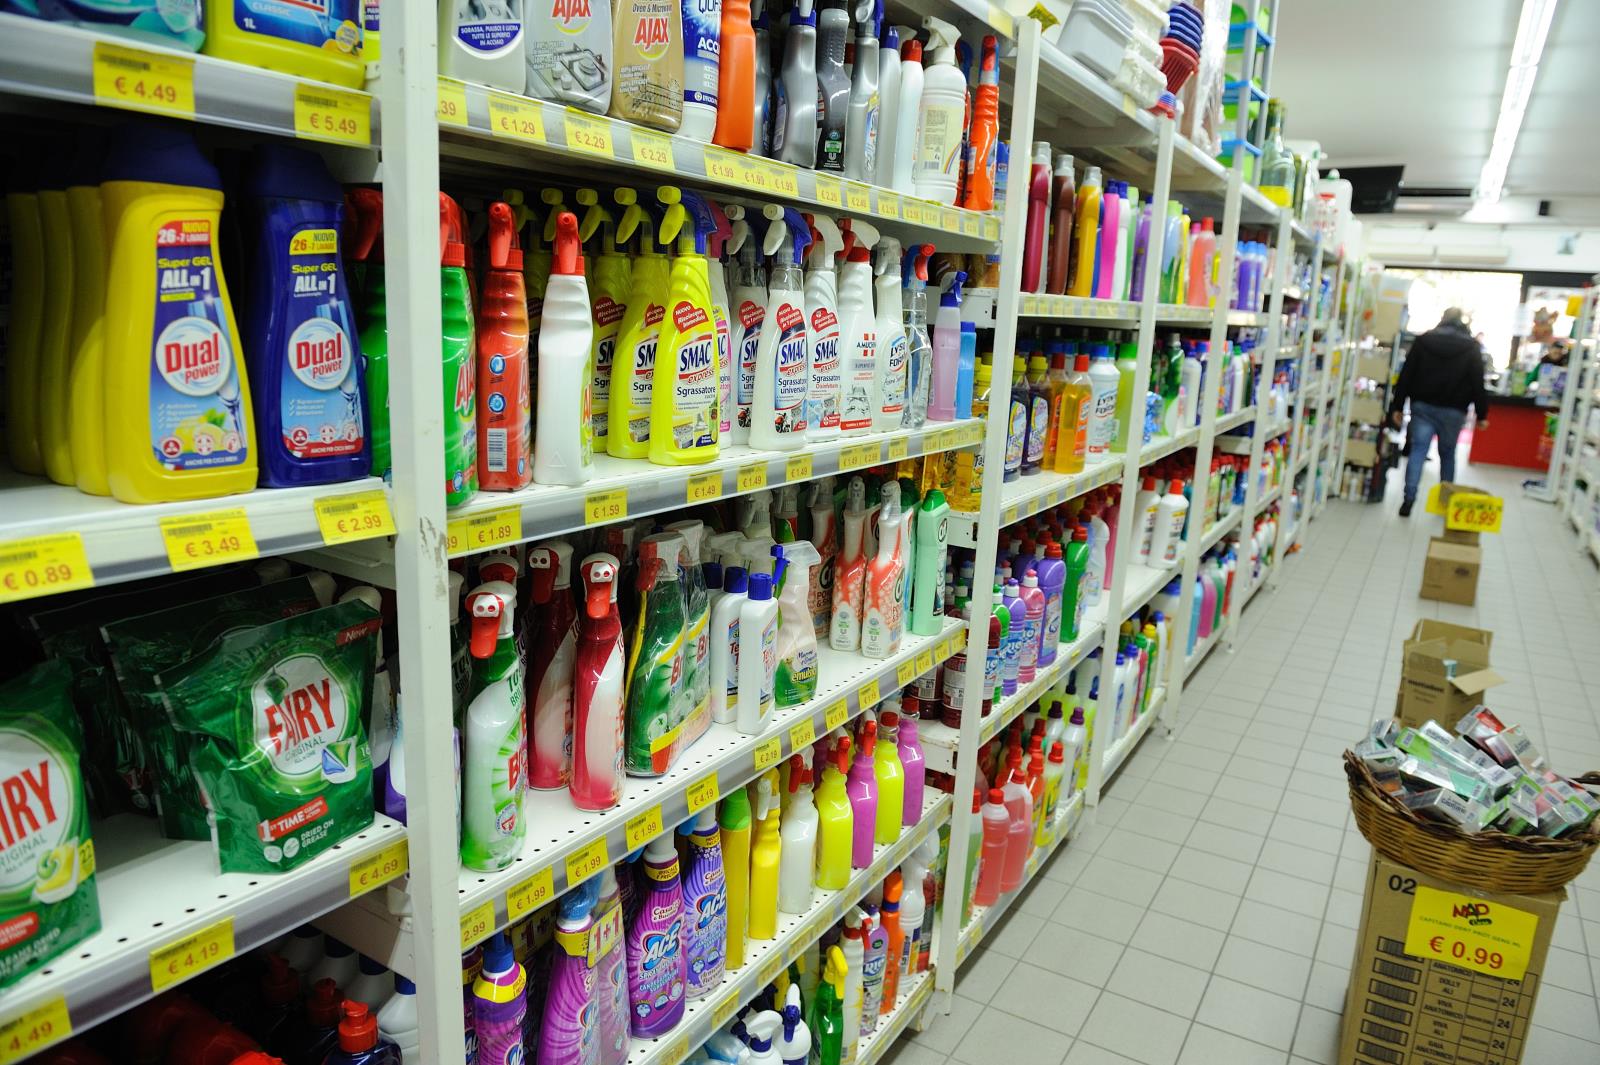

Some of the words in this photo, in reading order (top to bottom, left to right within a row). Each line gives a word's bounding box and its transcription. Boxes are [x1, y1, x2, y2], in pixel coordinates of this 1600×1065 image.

[243, 17, 256, 29] 1L
[633, 17, 669, 52] AJAX
[114, 76, 128, 95] €
[133, 82, 177, 104] 4.49
[309, 112, 321, 130] €
[324, 115, 358, 136] 5.49
[501, 117, 509, 130] €
[512, 119, 536, 135] 1.29
[574, 131, 582, 142] €
[585, 134, 606, 149] 2.29
[640, 149, 647, 160] €
[649, 150, 668, 164] 2.29
[711, 164, 718, 175] €
[719, 166, 734, 179] 1.99
[744, 172, 750, 182] €
[774, 179, 780, 190] €
[158, 228, 177, 244] 26
[292, 239, 307, 251] 26
[158, 258, 191, 269] Super
[191, 256, 212, 267] GEL
[292, 265, 320, 275] Super
[320, 262, 338, 272] GEL
[161, 269, 190, 289] ALL
[200, 266, 211, 291] 1
[294, 275, 318, 293] ALL
[327, 273, 336, 294] 1
[674, 304, 691, 316] NUOVO
[164, 332, 220, 374] Dual
[297, 333, 342, 370] Dual
[679, 341, 712, 372] SMAC
[780, 339, 805, 364] SMAC
[815, 340, 838, 362] SMAC
[687, 367, 715, 385] express
[676, 386, 716, 397] Sgrassatore
[742, 479, 749, 489] €
[749, 475, 763, 487] 1.49
[790, 469, 797, 479] €
[796, 467, 808, 477] 1.49
[694, 487, 701, 498] €
[701, 485, 717, 496] 1.49
[593, 507, 600, 518] €
[601, 504, 620, 517] 1.59
[1453, 508, 1462, 524] €
[1465, 509, 1497, 528] 0.99
[337, 519, 348, 534] €
[350, 514, 382, 532] 2.99
[478, 530, 485, 543] €
[488, 525, 511, 540] 1.89
[184, 541, 199, 558] €
[203, 536, 241, 557] 3.49
[3, 574, 20, 592] €
[23, 563, 73, 587] 0.89
[344, 627, 368, 643] New
[265, 677, 337, 757] FAIRY
[759, 753, 764, 763] €
[764, 748, 779, 760] 2.19
[693, 796, 701, 807] €
[700, 788, 714, 803] 4.19
[277, 810, 306, 833] TIME
[300, 825, 323, 841] DRIED
[322, 818, 335, 830] ON
[301, 829, 328, 848] GREASE
[633, 830, 640, 841] €
[640, 823, 657, 837] 1.99
[80, 843, 92, 864] 22
[358, 870, 369, 886] €
[370, 858, 399, 881] 4.69
[574, 867, 582, 878] €
[583, 855, 602, 872] 1.99
[1388, 874, 1417, 896] 02
[516, 899, 524, 911] €
[525, 886, 546, 906] 1.99
[700, 891, 727, 926] ACE
[463, 921, 486, 942] 2.99
[645, 930, 681, 964] ACE
[1429, 935, 1446, 954] €
[1452, 941, 1504, 971] 0.99
[167, 959, 179, 975] €
[184, 942, 220, 967] 4.19
[1424, 1004, 1464, 1020] ANATOMICO
[1502, 996, 1516, 1009] 24
[1497, 1017, 1511, 1030] 24
[8, 1021, 54, 1052] 4.49
[1491, 1039, 1506, 1051] 24
